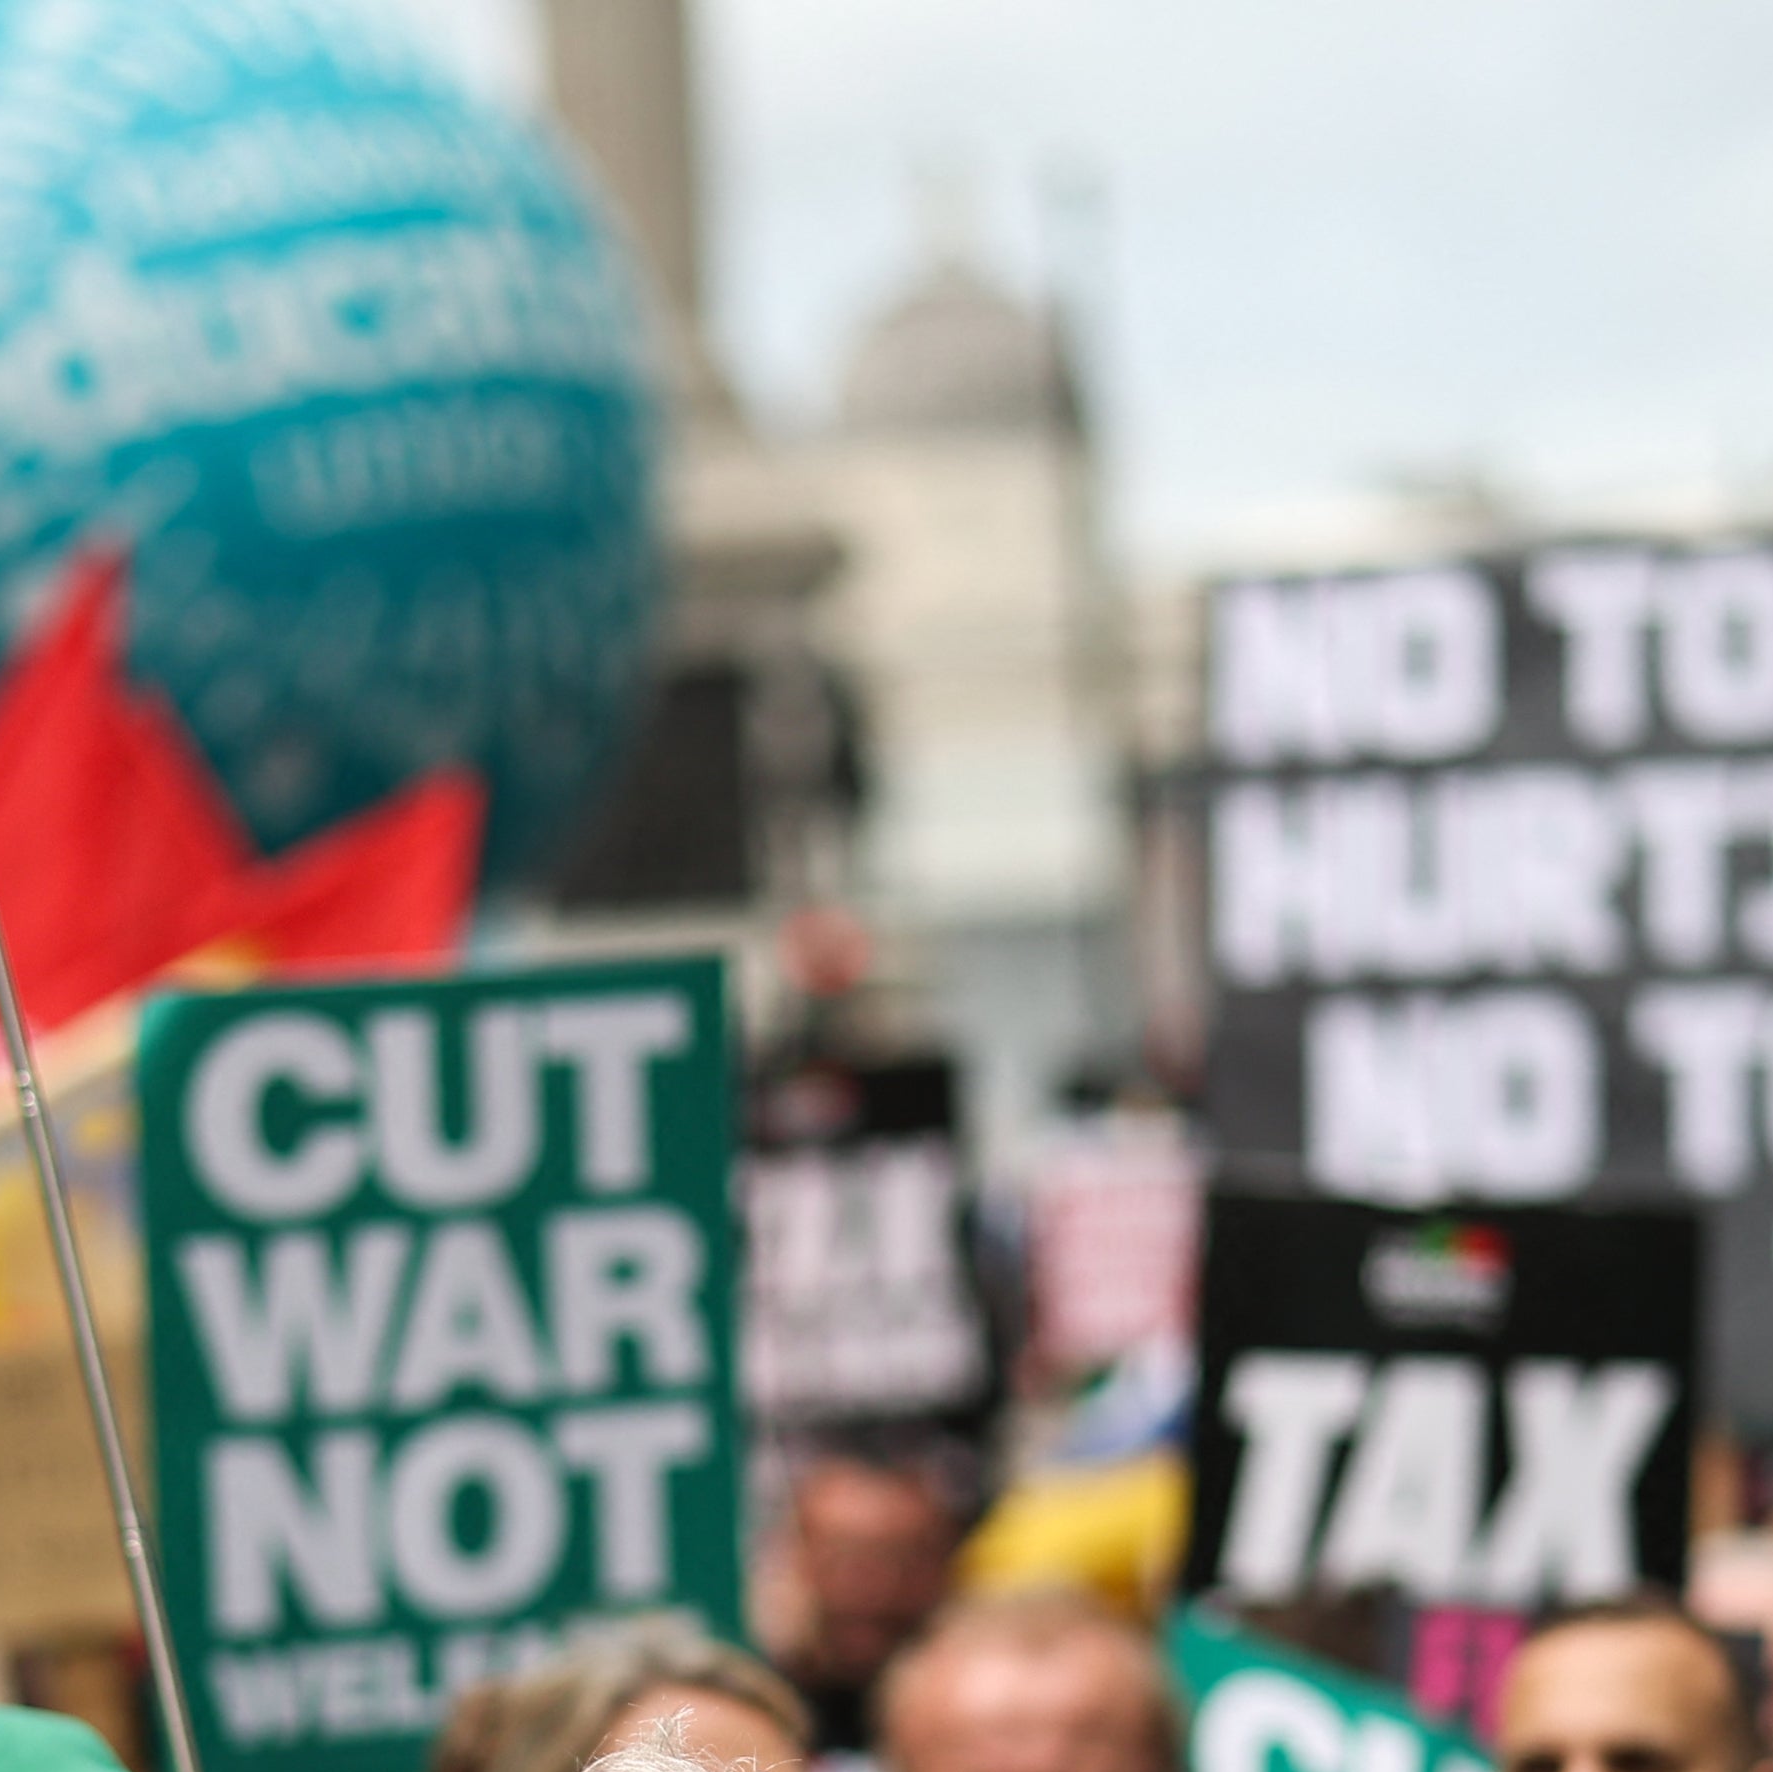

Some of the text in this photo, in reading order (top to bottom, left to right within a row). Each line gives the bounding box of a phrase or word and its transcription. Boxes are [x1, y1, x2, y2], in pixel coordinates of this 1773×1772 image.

[1211, 564, 1503, 764] NO
[184, 993, 692, 1222] CUT
[1305, 990, 1603, 1206] NO
[176, 1206, 712, 1424] WAR
[204, 1404, 711, 1636] NOT
[1220, 1350, 1677, 1602] TAX
